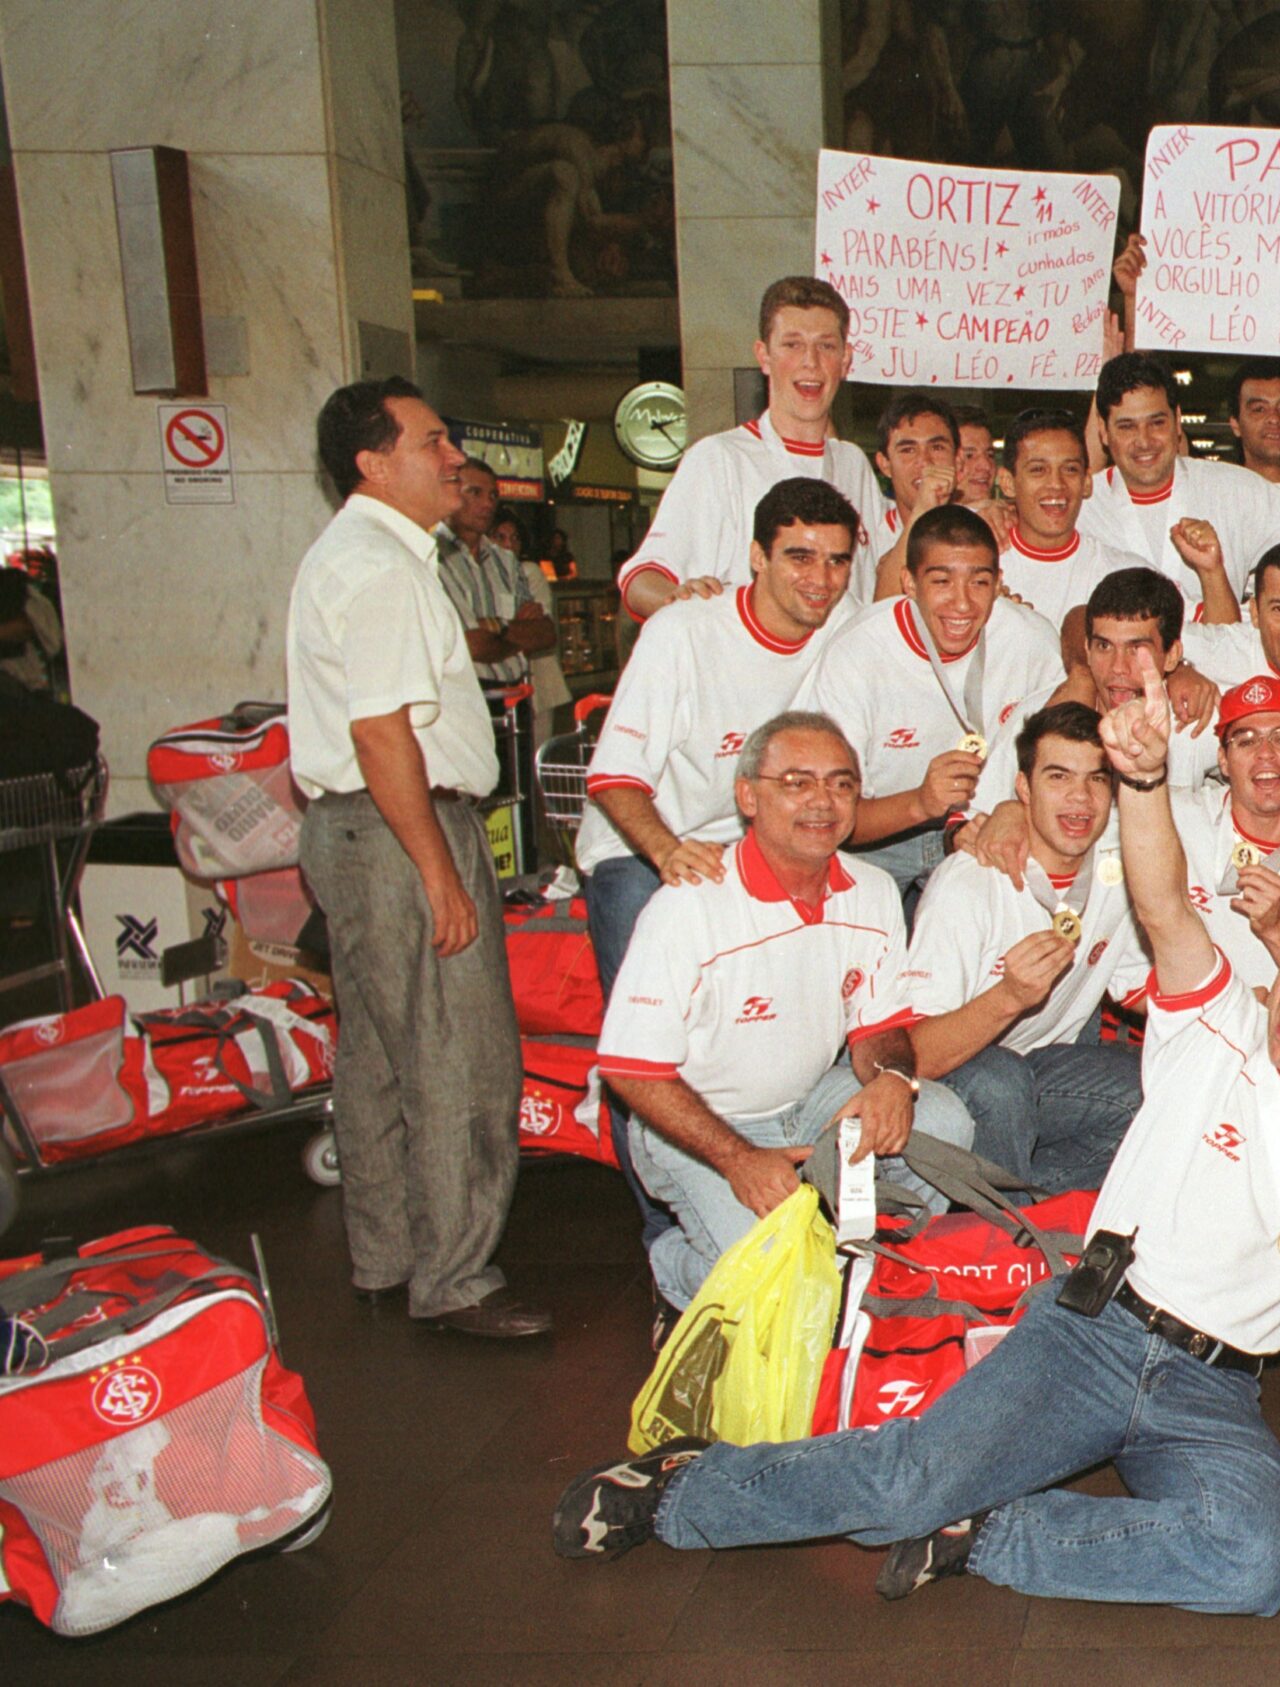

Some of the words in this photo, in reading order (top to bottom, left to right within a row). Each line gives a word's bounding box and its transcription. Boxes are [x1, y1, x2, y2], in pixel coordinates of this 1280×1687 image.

[1148, 126, 1196, 180] INTER
[821, 156, 877, 211] INTER
[907, 173, 1021, 227] ORTIZ
[1072, 179, 1117, 231] INTER
[1154, 189, 1167, 219] A
[843, 229, 990, 273] PARABÉNS!
[1028, 220, 1081, 246] irmãos
[1151, 223, 1242, 266] VOCÊS,
[1017, 248, 1096, 279] cunhados
[1155, 264, 1260, 298] ORGULHO
[828, 272, 879, 299] MAIS
[896, 275, 943, 305] UMA
[966, 281, 1012, 307] VEZ
[1039, 281, 1070, 308] TU
[848, 306, 910, 339] OSTE
[937, 309, 1050, 345] CAMPEÃO
[1136, 296, 1186, 348] INTER
[1209, 304, 1256, 343] LÉO
[735, 1013, 777, 1025] TOPPER
[1201, 1133, 1242, 1164] TOPPER
